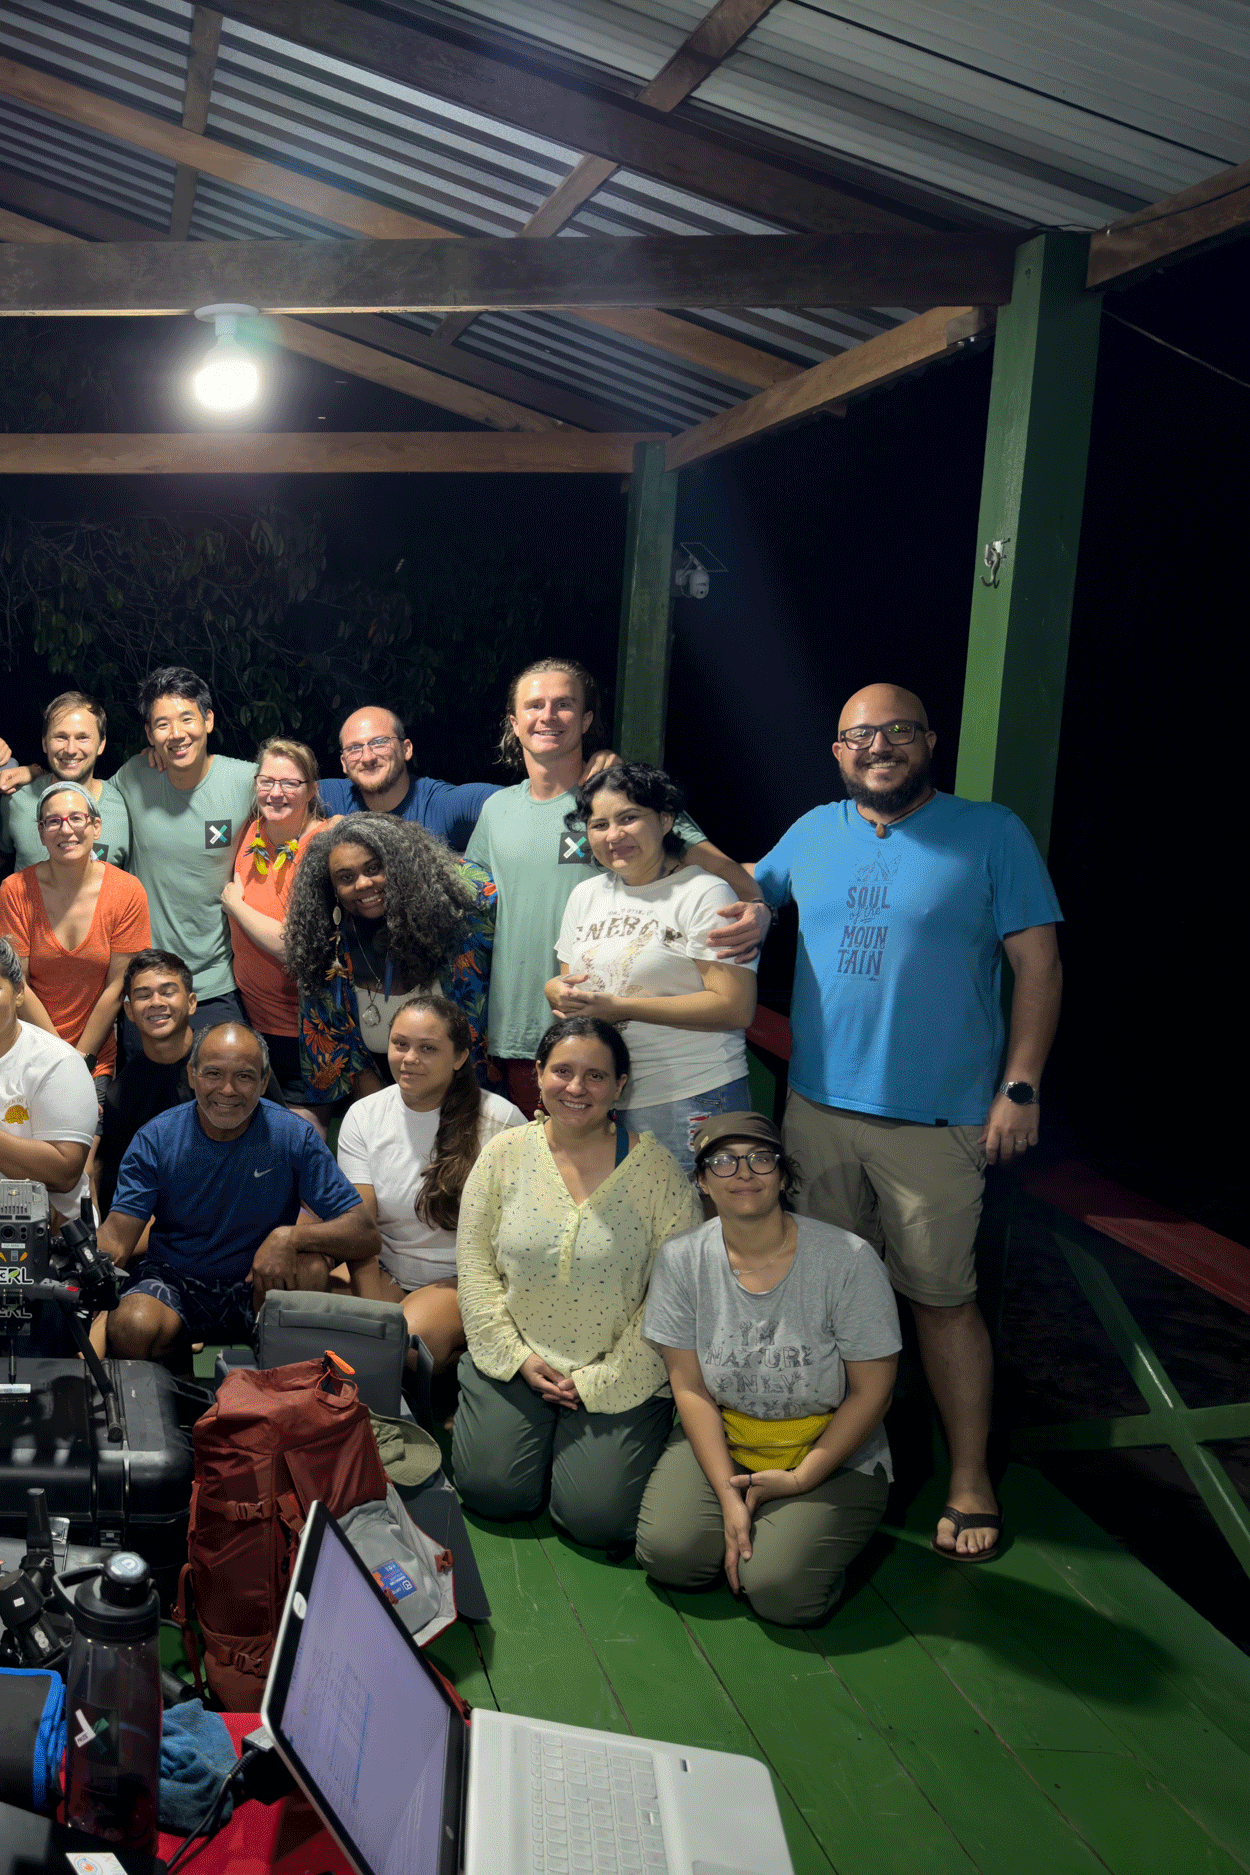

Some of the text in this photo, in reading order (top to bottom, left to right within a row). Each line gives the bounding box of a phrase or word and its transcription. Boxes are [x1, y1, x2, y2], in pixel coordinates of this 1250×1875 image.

[846, 886, 891, 909] SOUL
[839, 925, 889, 950] MOUN
[836, 949, 884, 976] TAIN
